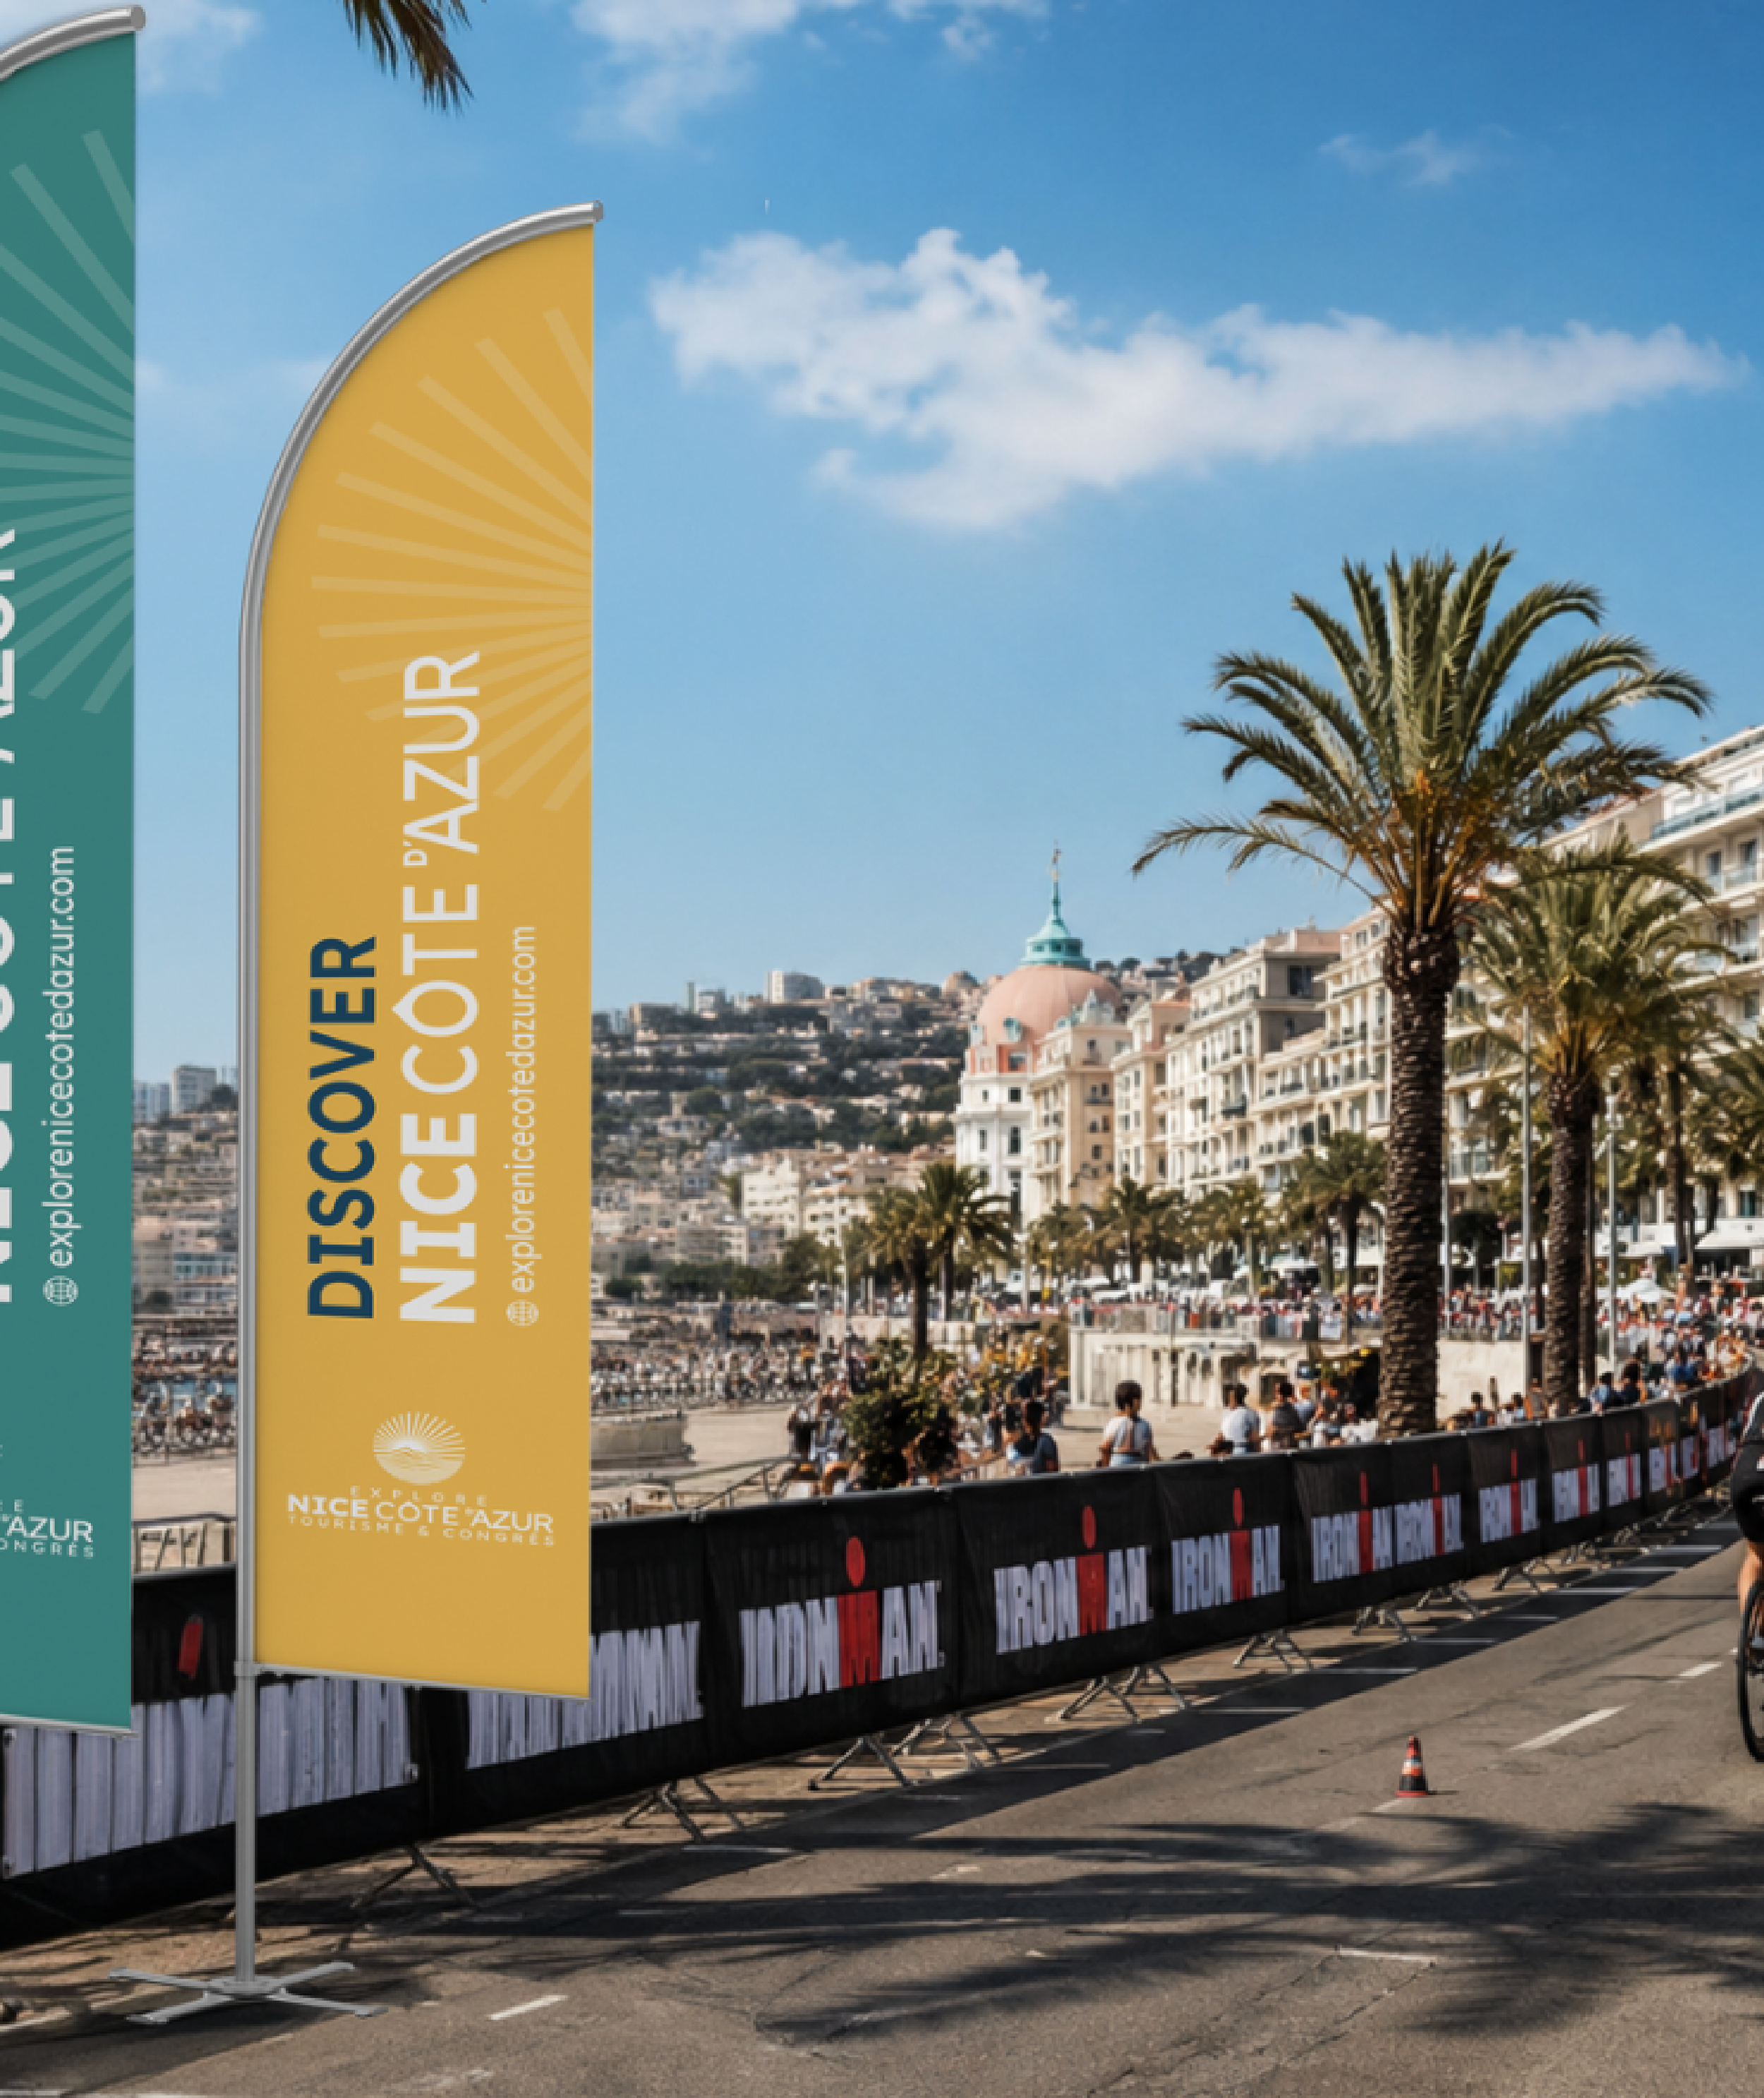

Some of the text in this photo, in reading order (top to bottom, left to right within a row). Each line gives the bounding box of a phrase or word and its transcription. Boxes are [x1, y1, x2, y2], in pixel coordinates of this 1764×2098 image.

[41, 845, 82, 1269] explorenicecotedazur.com
[392, 884, 480, 1095] CÔTE
[307, 936, 377, 1319] DISCOVER
[503, 927, 542, 1293] explorenicecotedazur.com
[399, 1113, 478, 1324] NICE
[288, 1493, 369, 1519] NICE
[375, 1501, 459, 1526] CÔTE
[288, 1514, 405, 1537] TOURISME
[417, 1524, 430, 1538] &
[350, 1485, 487, 1507] EXPLORE
